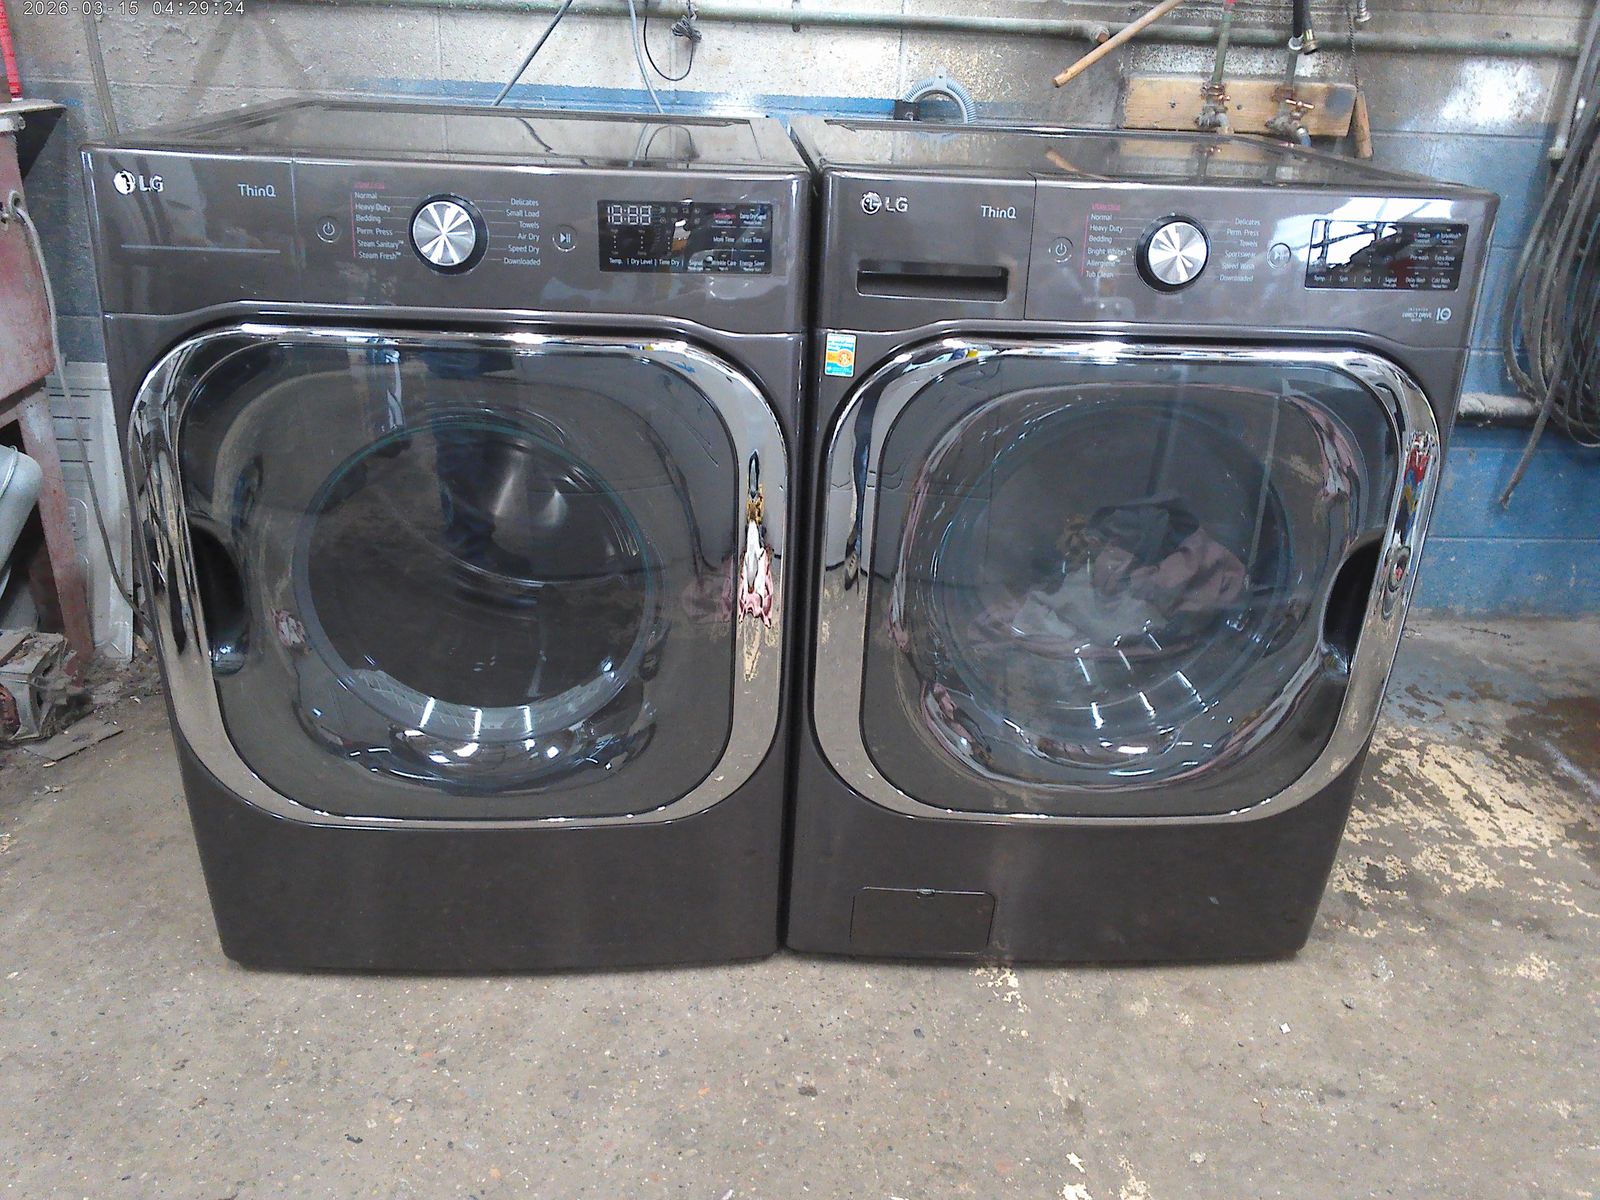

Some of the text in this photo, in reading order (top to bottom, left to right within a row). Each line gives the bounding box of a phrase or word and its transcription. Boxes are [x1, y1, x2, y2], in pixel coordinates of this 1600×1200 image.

[138, 175, 164, 192] LG
[237, 184, 276, 197] ThinQ
[510, 198, 539, 206] Delicates
[885, 196, 908, 213] LG
[355, 203, 391, 212] Heavy Duty
[981, 205, 1017, 219] ThinQ
[506, 209, 523, 217] Small
[1090, 213, 1112, 221] Normal
[355, 214, 381, 224] Bedding
[519, 221, 540, 229] Towels
[1108, 225, 1123, 233] Duty
[375, 228, 393, 236] Press
[528, 233, 540, 242] Dry
[1088, 235, 1112, 244] Bedding
[508, 244, 540, 254] Speed Dry
[503, 257, 541, 266] Downloaded
